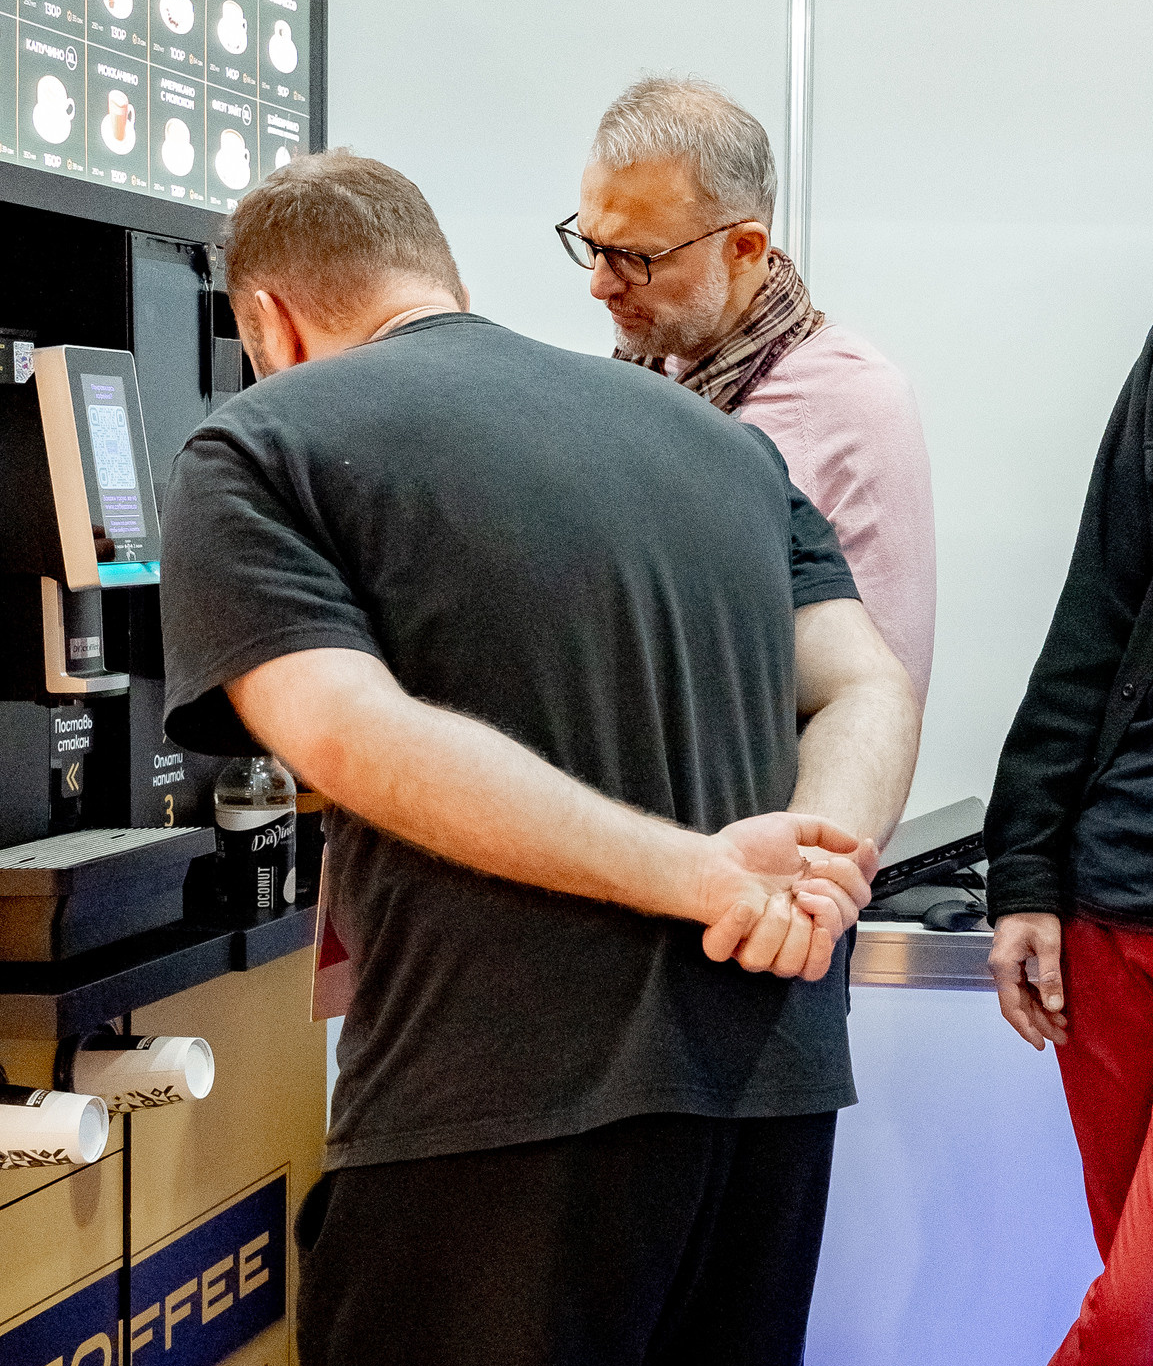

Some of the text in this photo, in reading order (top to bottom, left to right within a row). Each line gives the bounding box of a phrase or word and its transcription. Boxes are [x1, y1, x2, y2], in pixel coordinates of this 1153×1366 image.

[54, 714, 93, 734] Поставь
[57, 735, 90, 753] стакан
[153, 752, 184, 769] Оплати
[152, 767, 185, 787] напиток
[164, 794, 174, 827] 3
[257, 866, 271, 908] OCONUT
